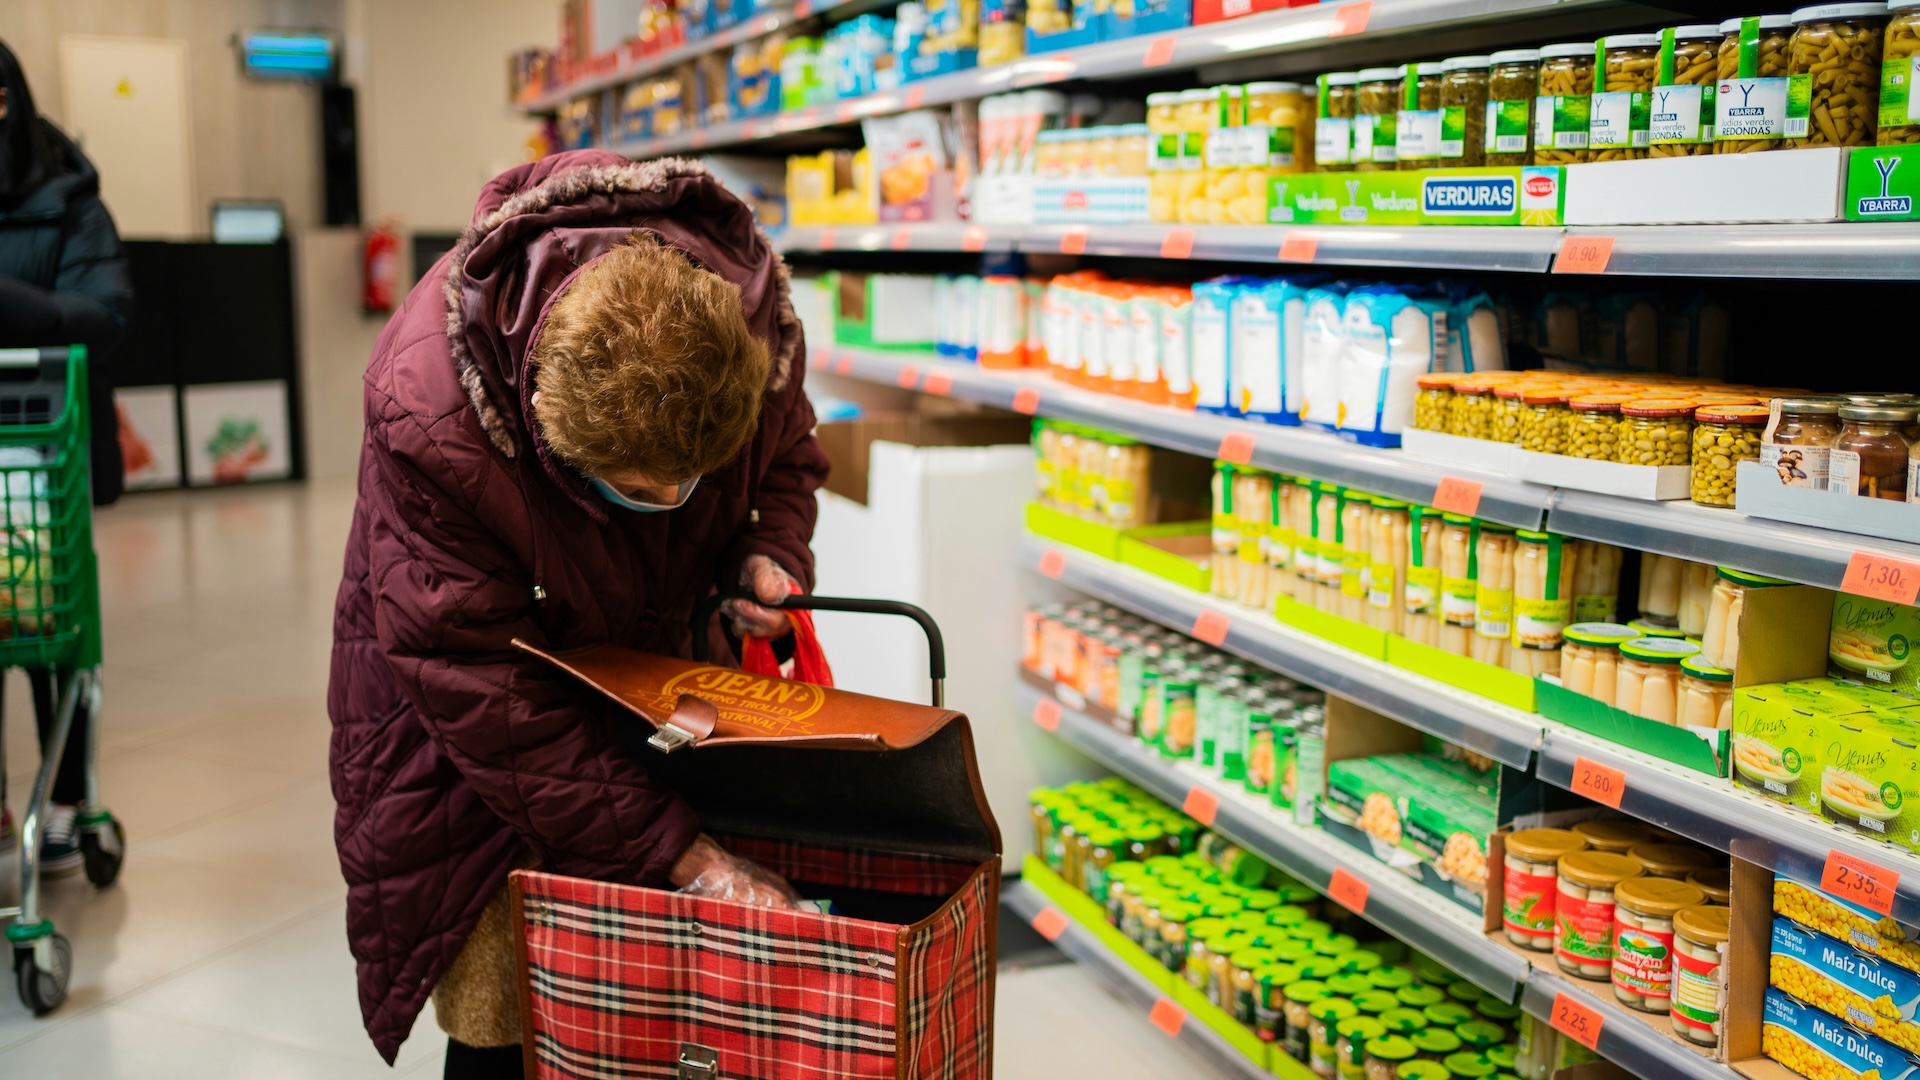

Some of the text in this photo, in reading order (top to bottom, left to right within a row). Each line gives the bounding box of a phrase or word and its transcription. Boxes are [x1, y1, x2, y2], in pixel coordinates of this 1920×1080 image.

[1662, 121, 1686, 131] verdes
[1721, 116, 1775, 126] Judías verdes
[1723, 127, 1771, 135] REDONDAS
[1873, 157, 1901, 197] Y
[1295, 191, 1337, 211] Verduras
[1371, 190, 1418, 211] Verduras
[1426, 184, 1513, 208] VERDURAS
[1861, 200, 1908, 212] YBARRA
[1838, 601, 1899, 633] Yemas
[699, 670, 802, 705] JEAN
[741, 699, 799, 718] TROLLEY
[1737, 710, 1790, 741] Yemas
[1827, 742, 1890, 775] Yemas
[1836, 866, 1881, 898] 2,35€
[1822, 948, 1855, 975] Maíz
[1859, 963, 1897, 993] Dulce
[1812, 1019, 1884, 1068] Maíz Dulce
